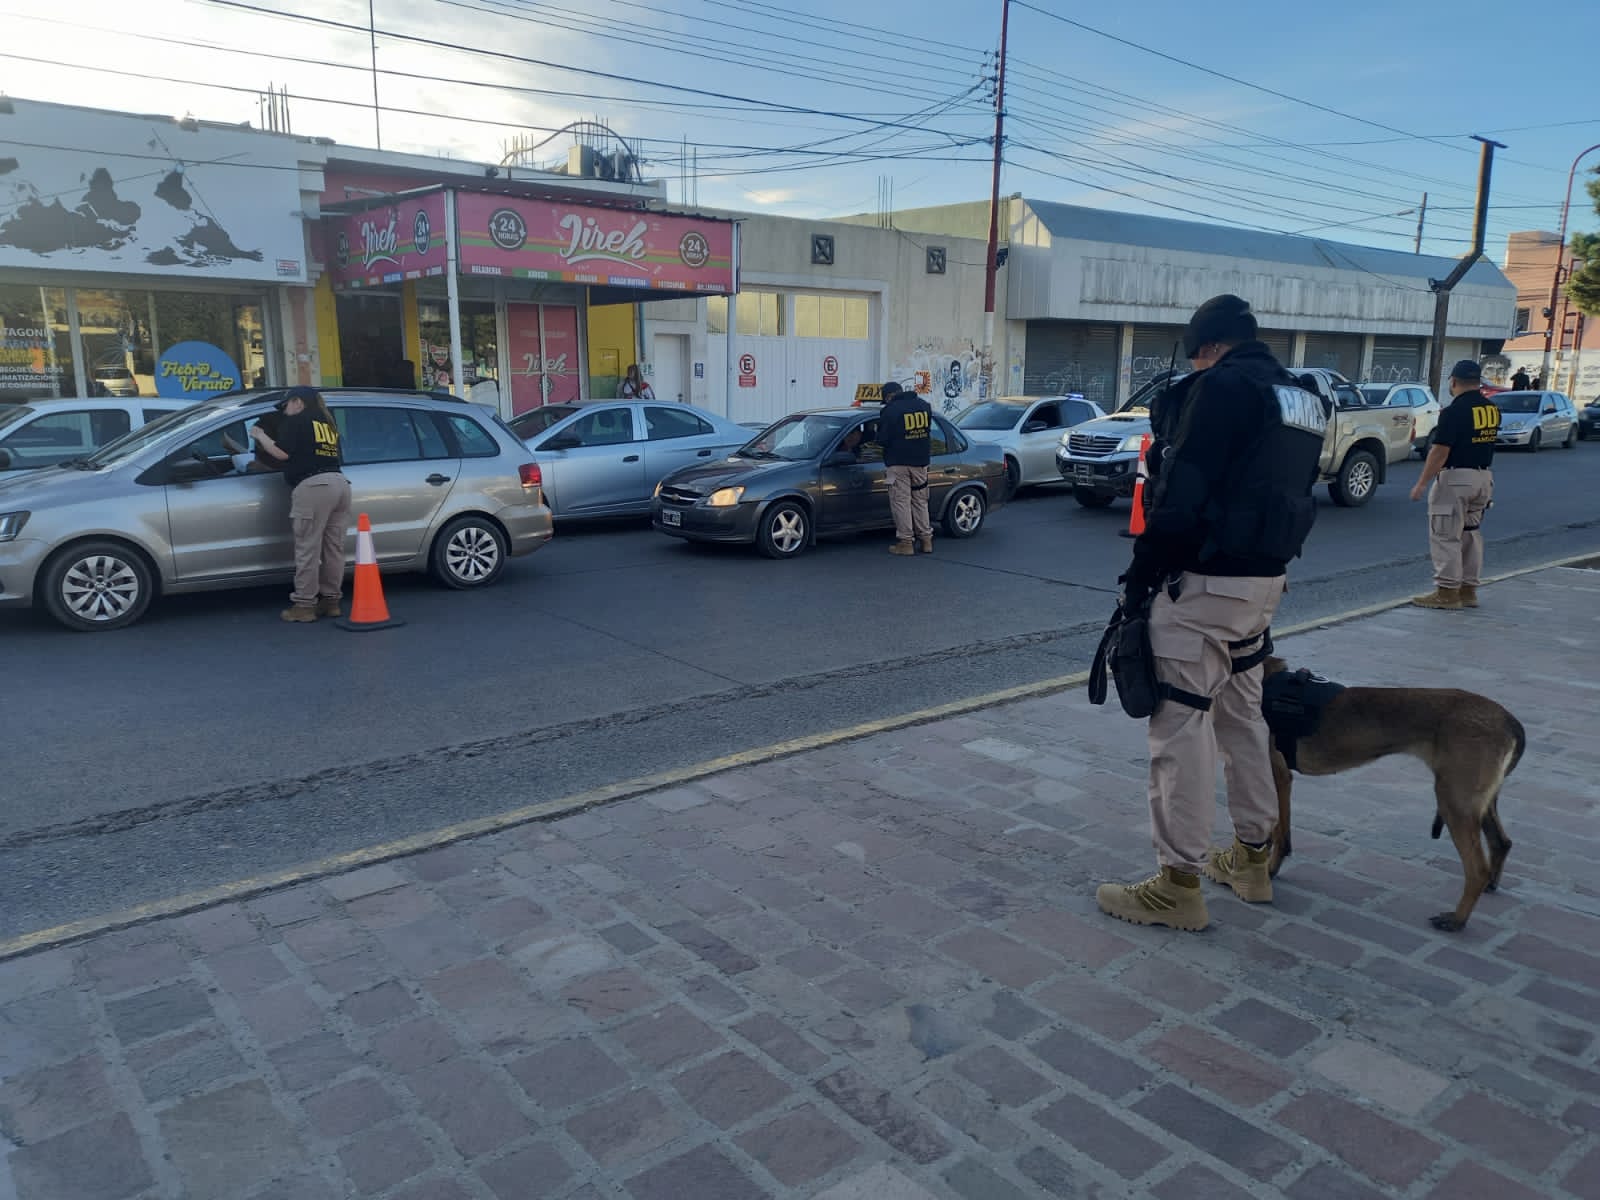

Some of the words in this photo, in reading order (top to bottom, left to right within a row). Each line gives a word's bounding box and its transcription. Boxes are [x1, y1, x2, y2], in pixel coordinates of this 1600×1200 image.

[500, 217, 516, 232] 24
[361, 220, 397, 265] Jireh
[498, 231, 520, 241] HORAS
[559, 213, 648, 259] Jireh
[687, 239, 701, 252] 24
[0, 327, 56, 338] TAGONIA
[179, 375, 235, 392] Verano
[904, 411, 929, 431] DDI
